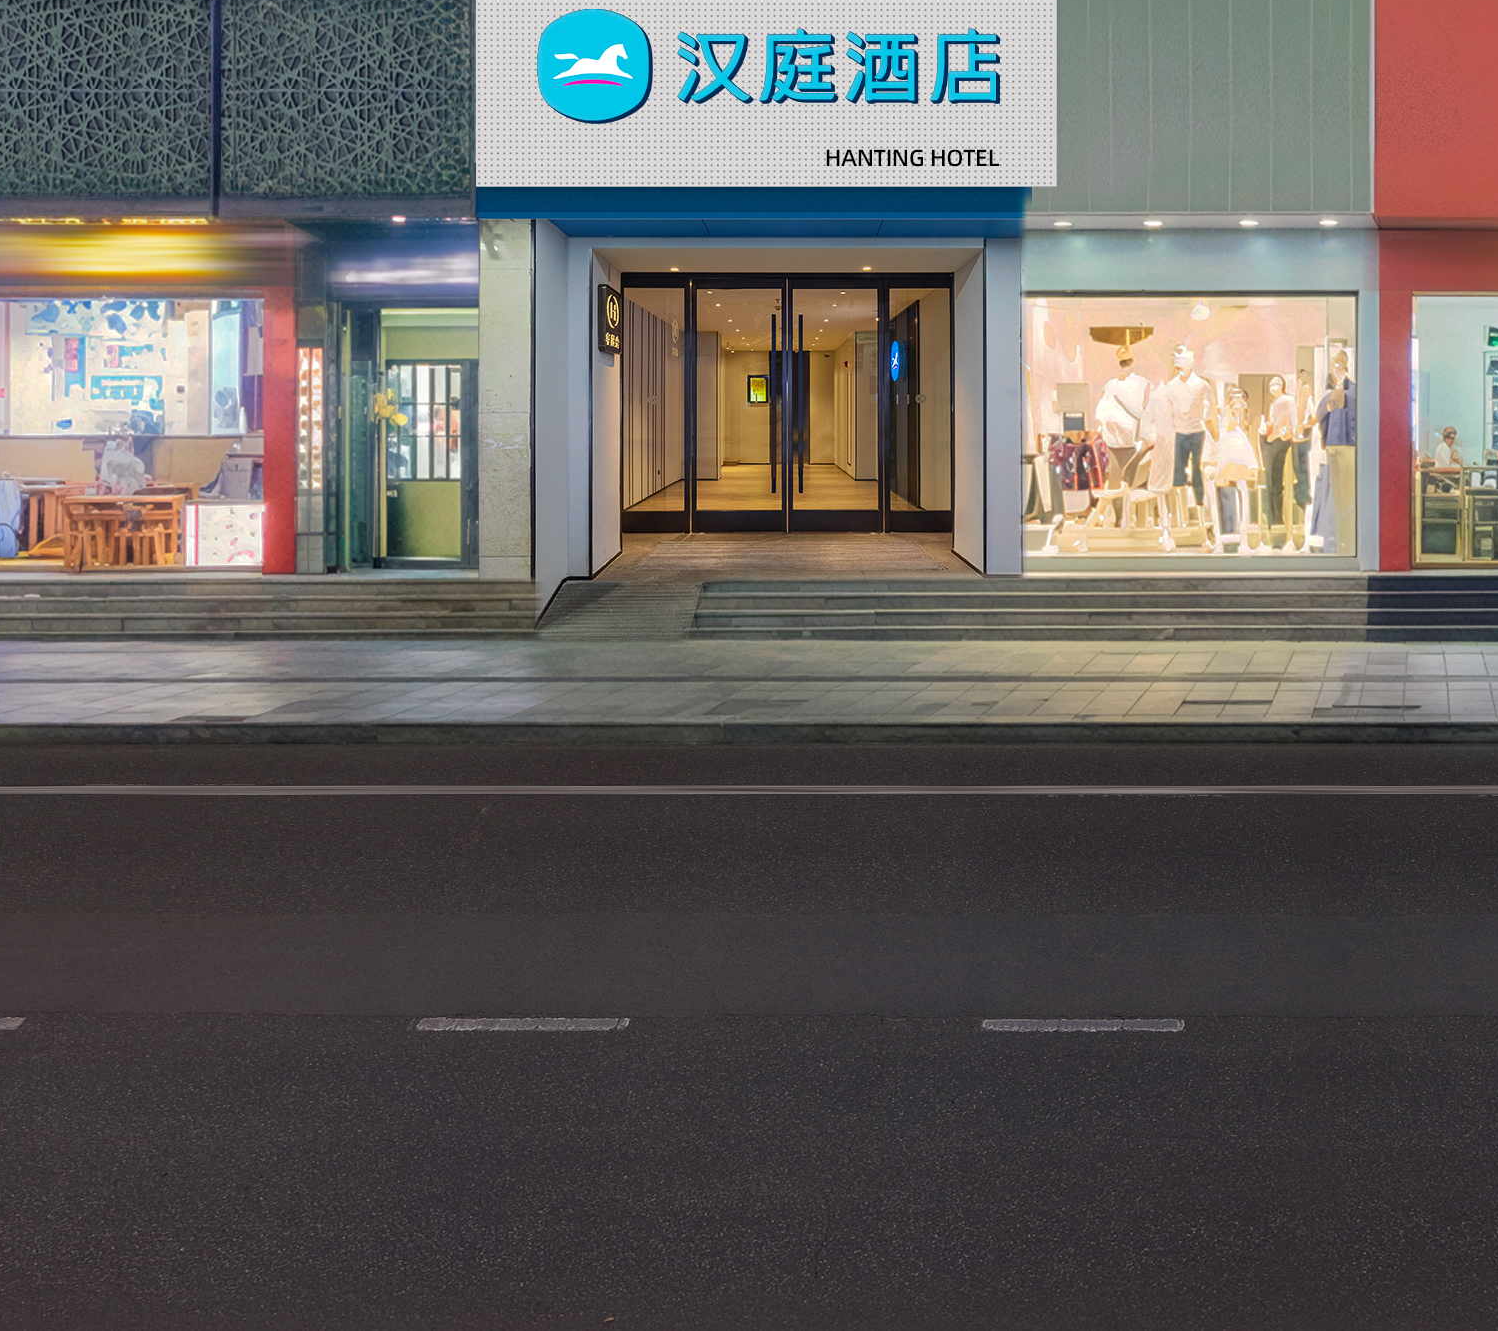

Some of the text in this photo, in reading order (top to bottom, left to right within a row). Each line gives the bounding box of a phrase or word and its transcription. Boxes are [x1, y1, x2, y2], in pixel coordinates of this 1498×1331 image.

[676, 27, 1001, 105] 汉庭酒店
[825, 148, 1000, 168] HANTING HOTEL
